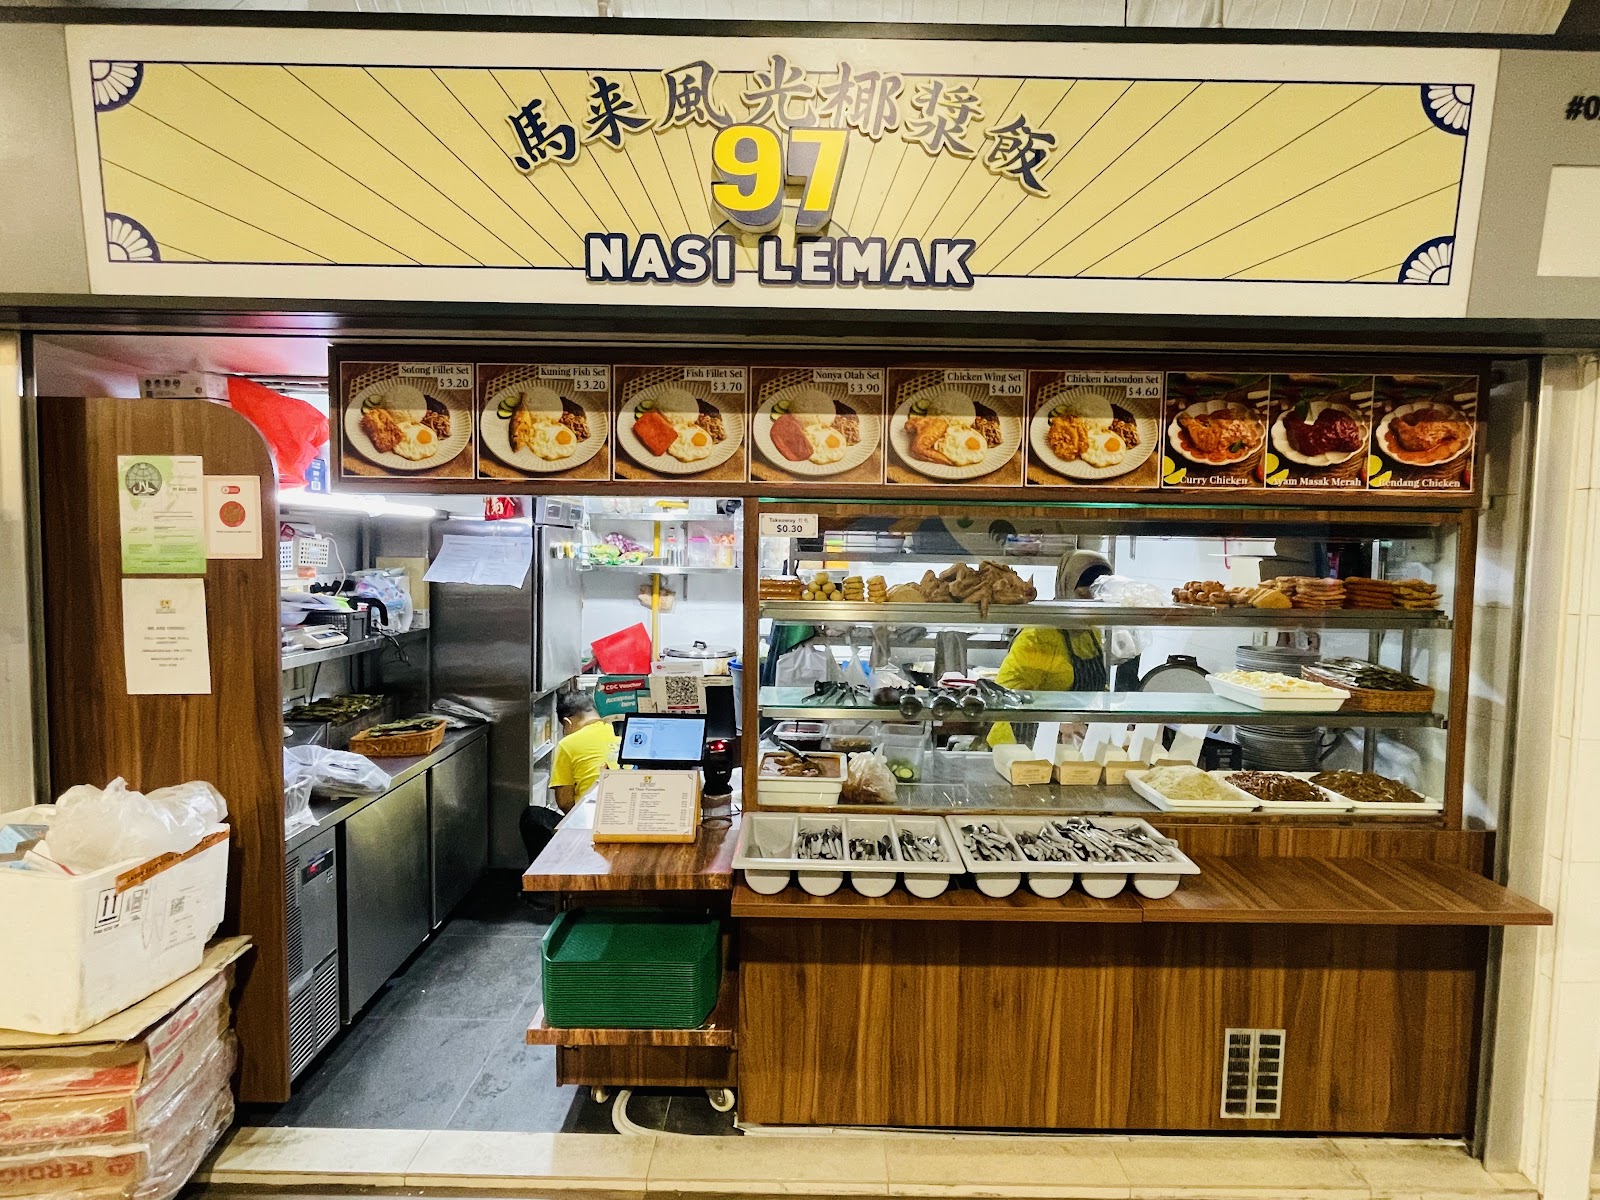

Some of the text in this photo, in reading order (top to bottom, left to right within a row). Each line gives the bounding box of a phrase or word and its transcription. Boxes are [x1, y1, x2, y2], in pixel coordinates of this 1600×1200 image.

[1565, 95, 1600, 120] #0
[712, 124, 849, 227] 97
[587, 233, 974, 287] NASI LEMAK
[402, 366, 469, 375] Sotong Fillet Set
[541, 368, 605, 377] Kuning Fish Set
[687, 369, 742, 377] Fish Fillet Set
[816, 371, 879, 380] Nonya Otah Set
[948, 372, 1020, 382] Chicken Wing Set
[1066, 374, 1101, 383] Chicken
[1104, 374, 1143, 383] Katsudon
[1180, 476, 1248, 485] Curry Chicken
[1300, 477, 1329, 486] Masak
[1332, 477, 1361, 486] Merah
[1421, 479, 1460, 488] Chicken
[777, 525, 802, 533] $0.30
[605, 683, 618, 691] CDC
